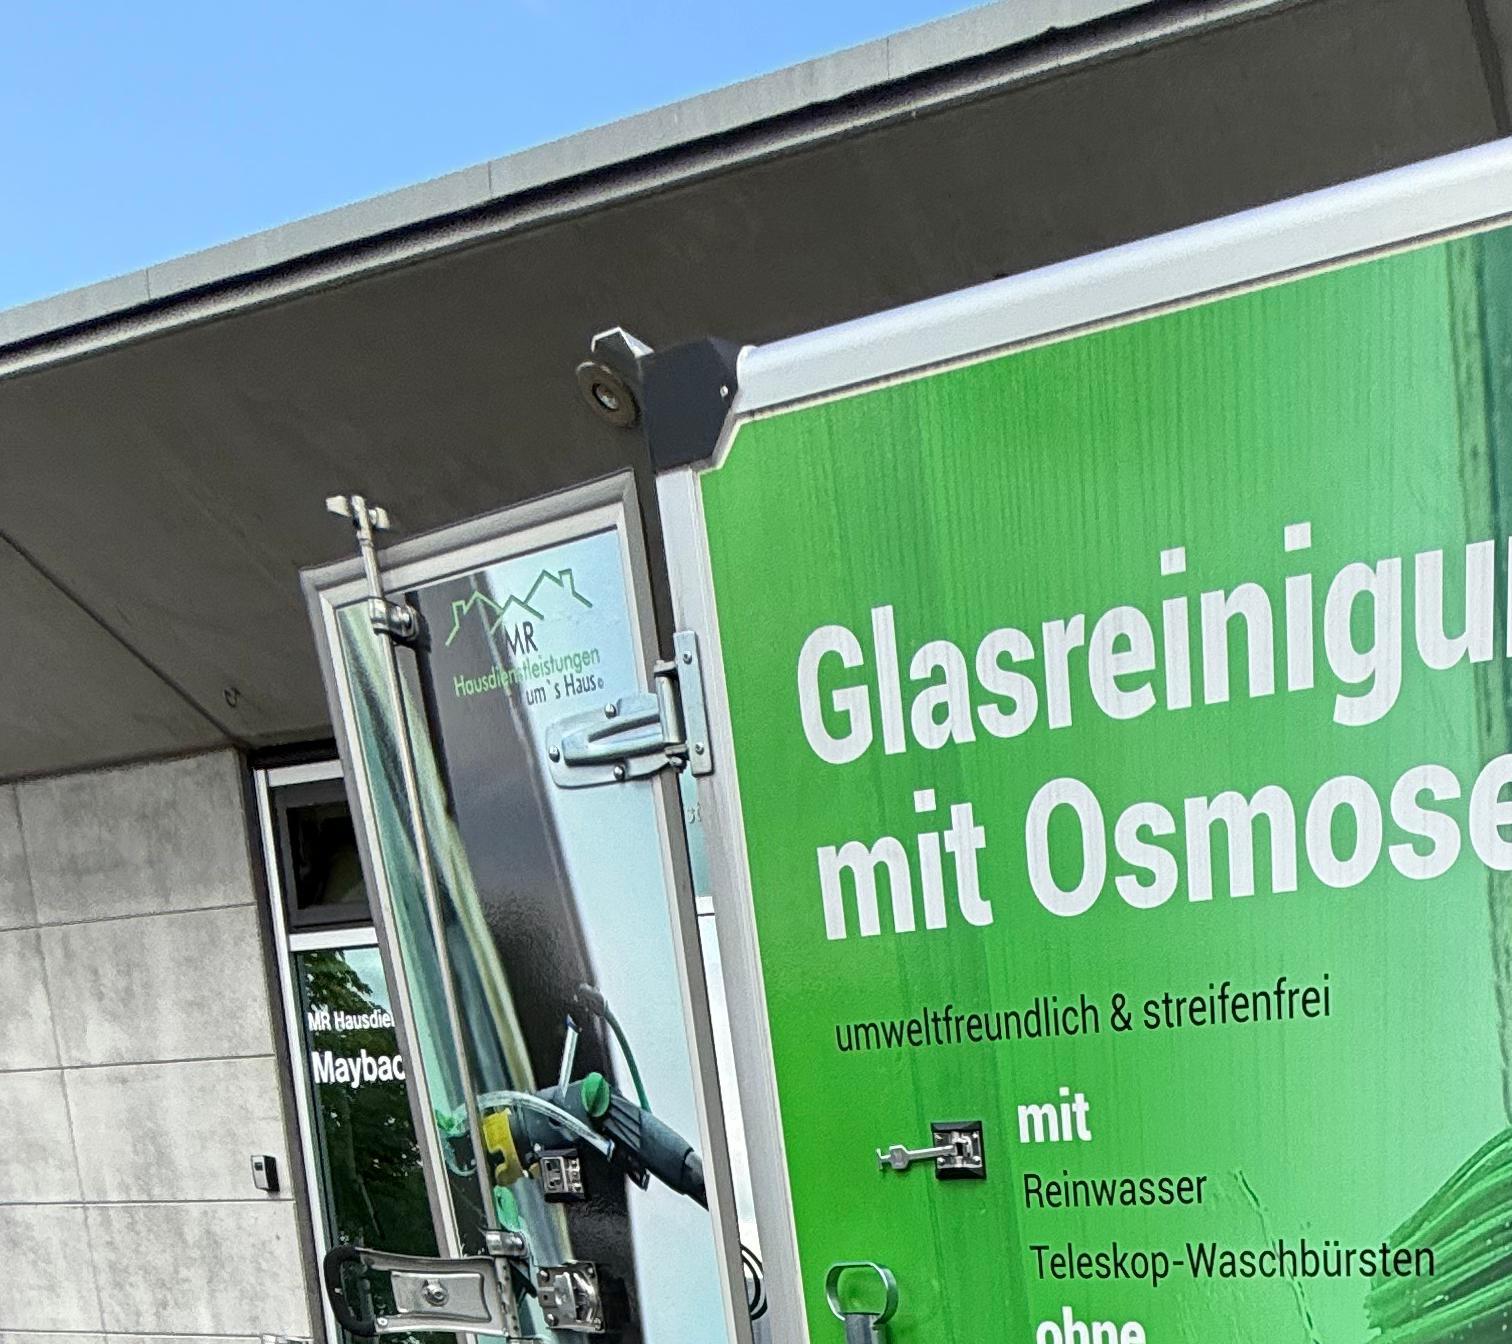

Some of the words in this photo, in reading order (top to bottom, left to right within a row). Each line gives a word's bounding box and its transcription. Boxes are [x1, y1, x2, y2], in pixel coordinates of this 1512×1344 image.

[504, 621, 538, 656] MR
[816, 789, 993, 939] mit
[308, 1011, 331, 1031] MR
[835, 993, 1099, 1052] umweltfreundlich
[1110, 992, 1133, 1032] &
[1142, 973, 1331, 1030] streifenfrei
[1017, 1087, 1092, 1144] mit
[1024, 1170, 1207, 1209] Reinwasser
[1030, 1239, 1435, 1287] Teleskop-Waschbürsten
